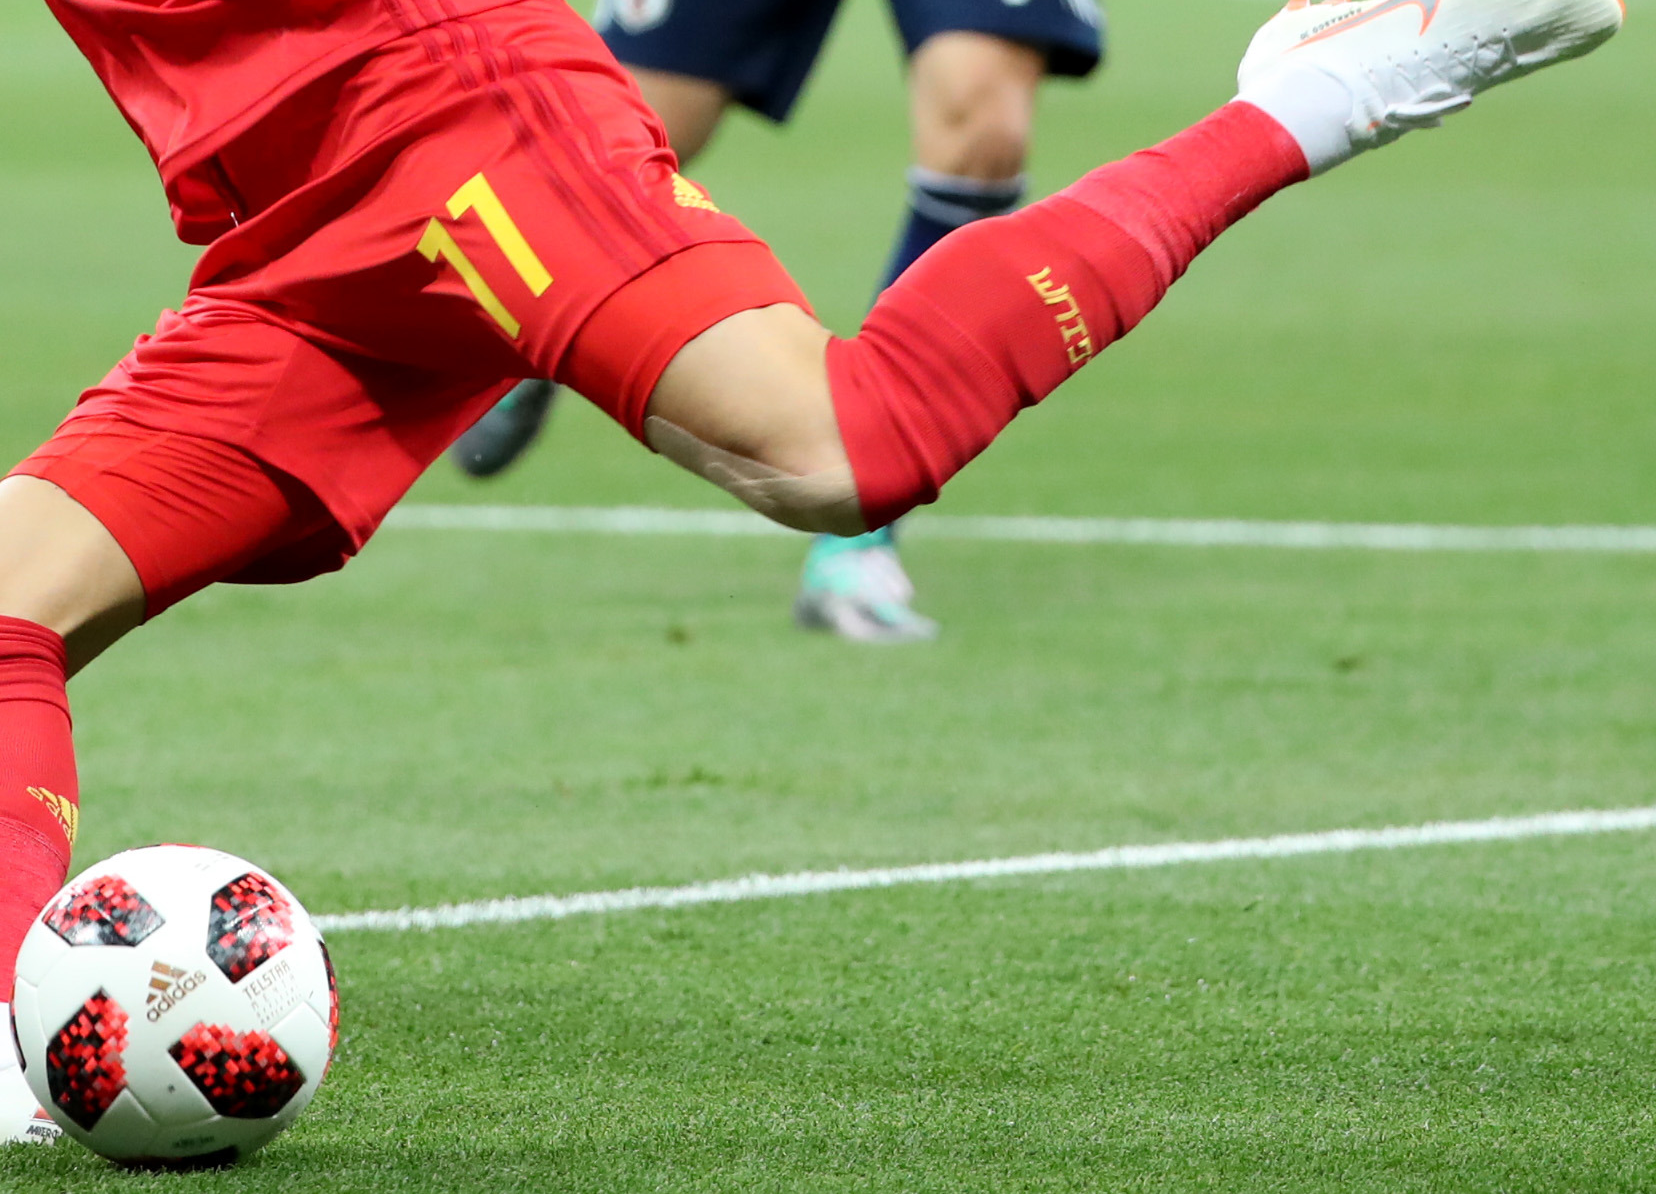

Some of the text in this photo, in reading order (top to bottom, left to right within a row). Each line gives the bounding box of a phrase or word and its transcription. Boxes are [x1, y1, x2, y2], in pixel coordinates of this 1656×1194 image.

[416, 172, 554, 339] 11
[146, 970, 207, 1023] adidas
[242, 959, 291, 1001] TELSTAR
